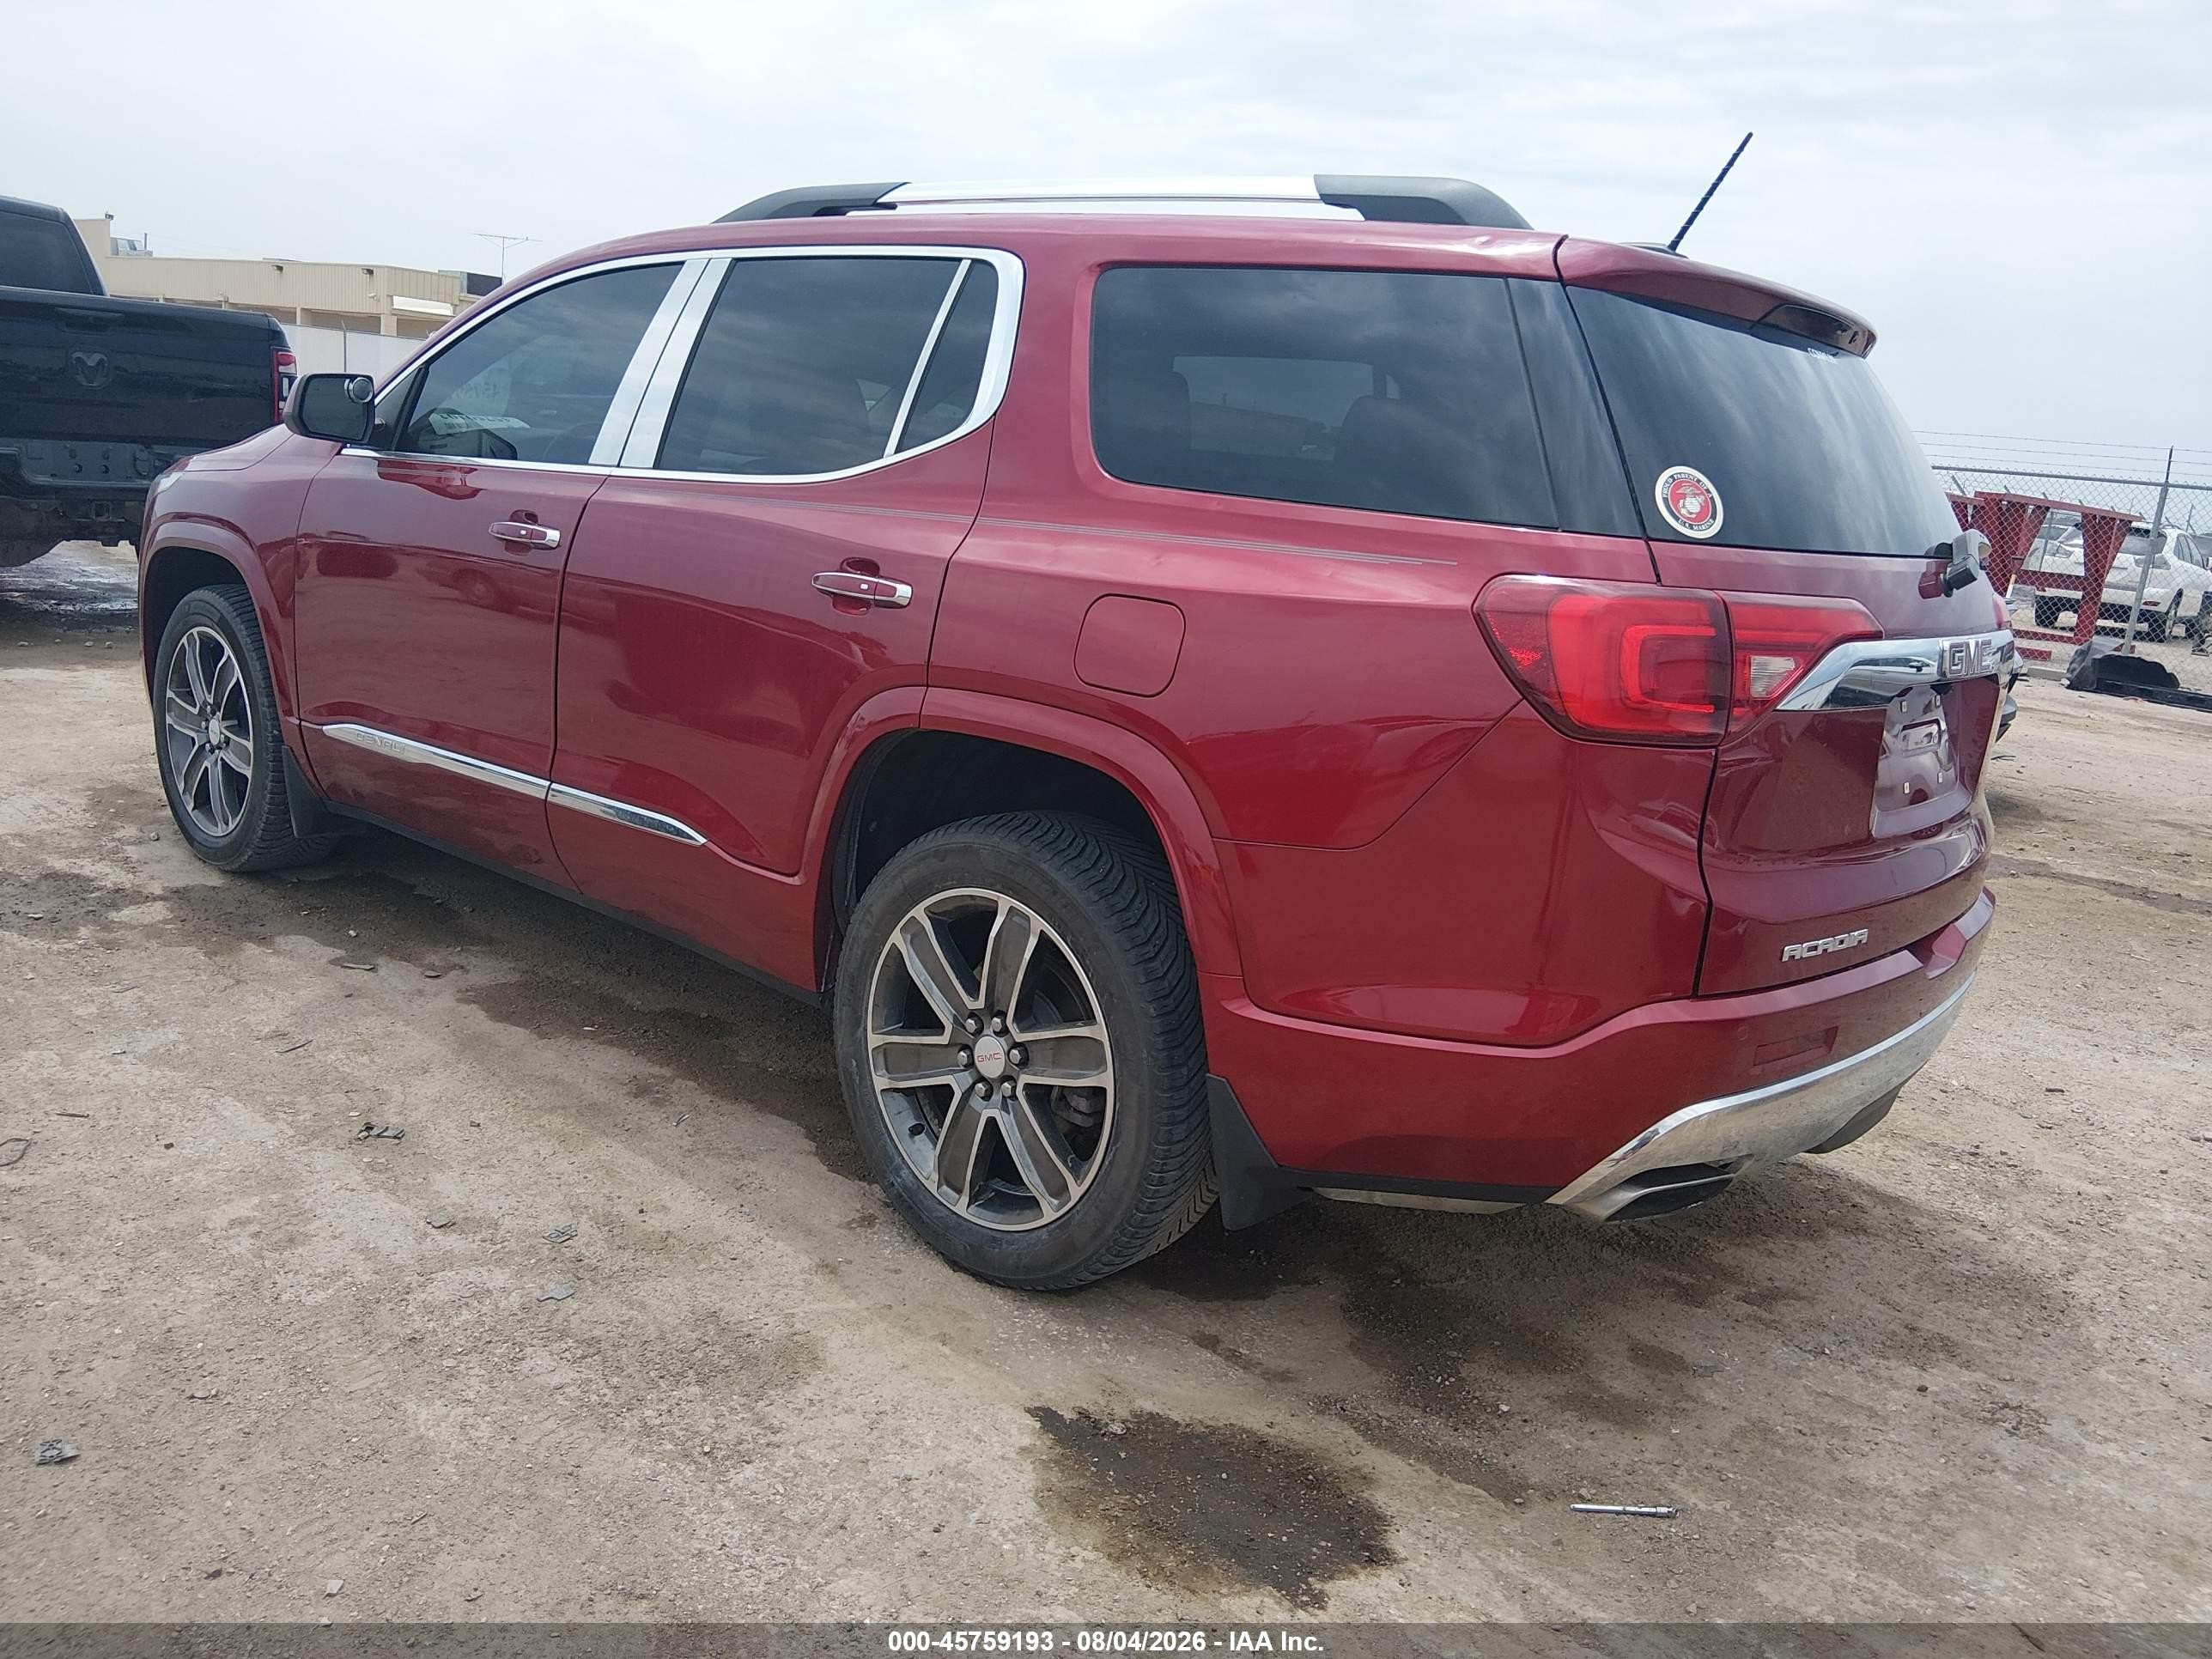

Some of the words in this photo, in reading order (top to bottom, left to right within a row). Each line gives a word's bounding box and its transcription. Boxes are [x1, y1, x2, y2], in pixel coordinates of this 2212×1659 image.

[1674, 473, 1698, 482] PARENT
[1692, 519, 1714, 530] MARINE
[1948, 639, 1993, 677] GMC
[1782, 928, 1869, 962] ACADIA
[976, 1052, 1001, 1062] GMC
